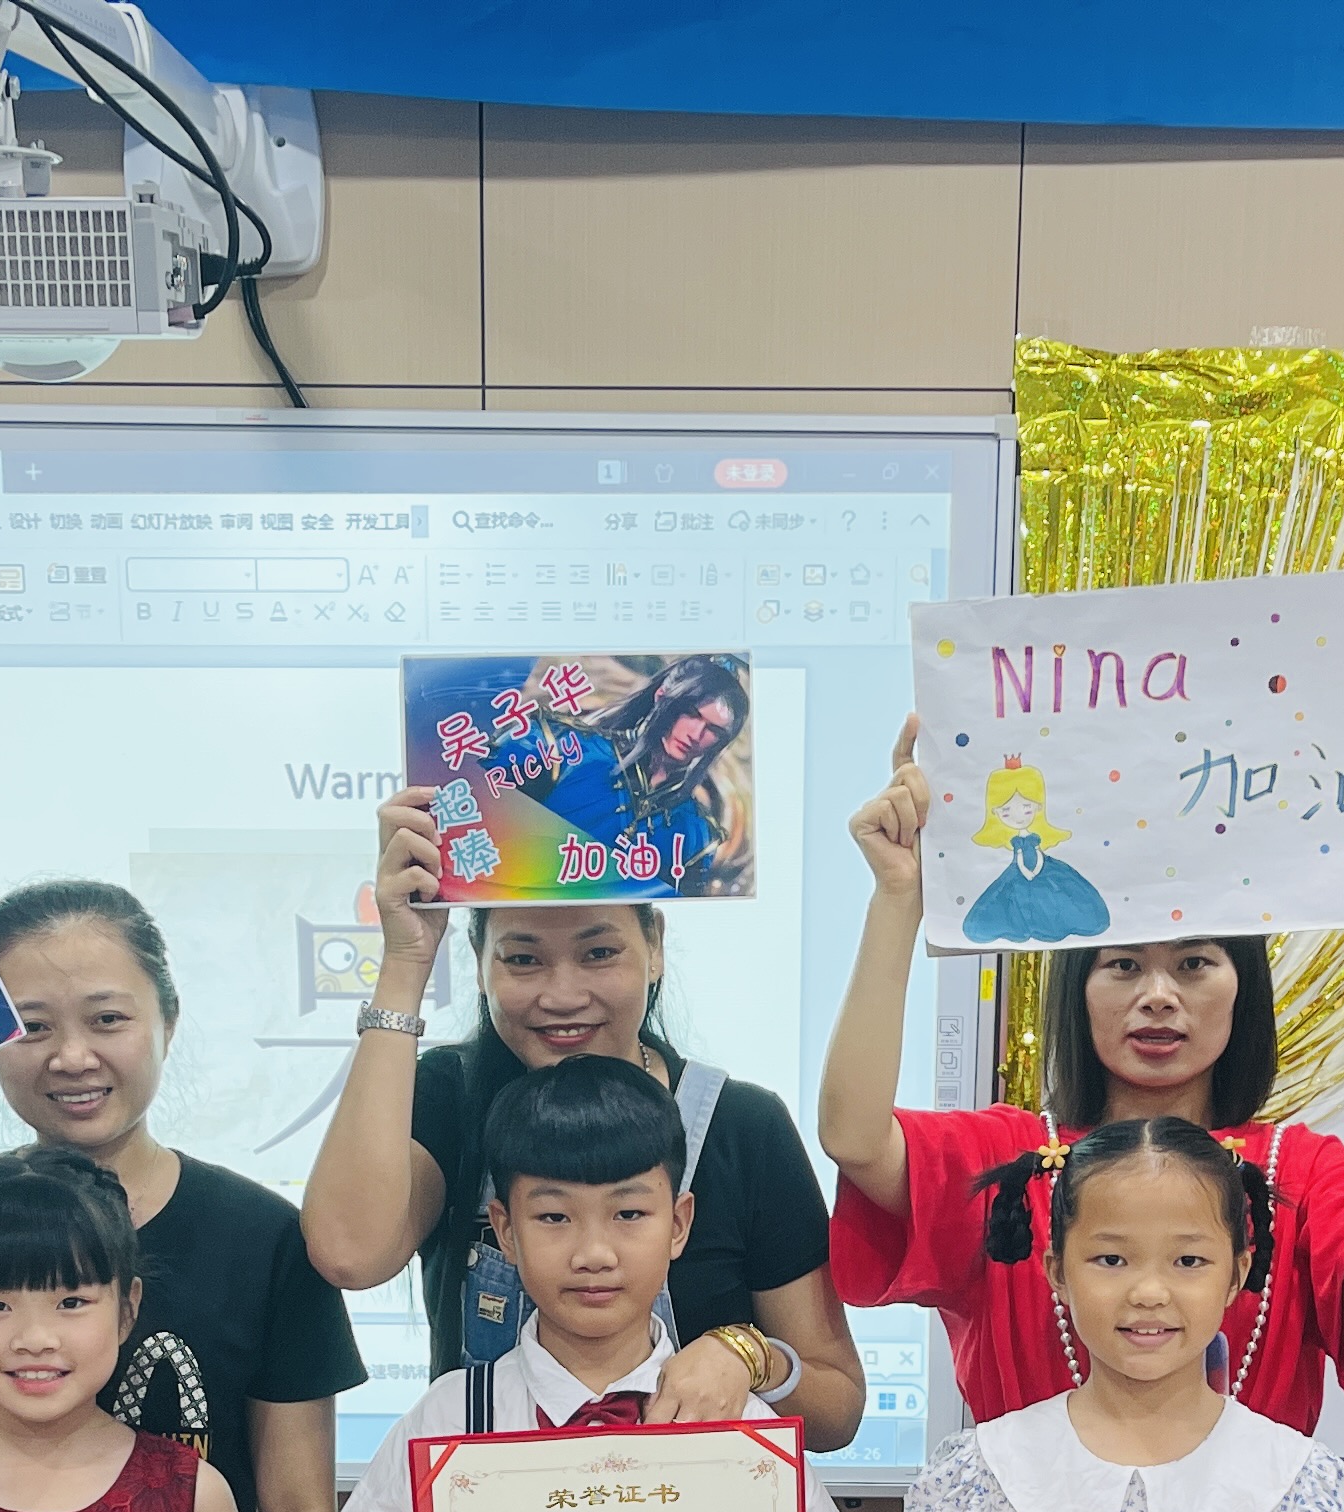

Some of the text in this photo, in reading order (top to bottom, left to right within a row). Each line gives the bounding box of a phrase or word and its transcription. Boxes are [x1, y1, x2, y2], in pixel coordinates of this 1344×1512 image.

[725, 464, 776, 482] 未登录
[9, 513, 41, 531] 设计
[50, 513, 83, 531] 切换
[90, 513, 123, 531] 动画
[131, 513, 213, 531] 幻灯片放映
[220, 513, 253, 531] 审阅
[260, 513, 294, 531] 视图
[301, 513, 334, 531] 安全
[346, 513, 410, 531] 开发工具
[604, 512, 638, 530] 分享
[680, 513, 714, 531] 批注
[755, 513, 805, 531] 未同步
[74, 567, 107, 584] 重置
[991, 644, 1191, 718] Nina
[436, 661, 595, 771] 吴子华
[486, 730, 585, 798] Ricky
[430, 778, 503, 882] 超棒
[558, 833, 687, 884] 加油!
[545, 1484, 681, 1510] 荣誉证书
